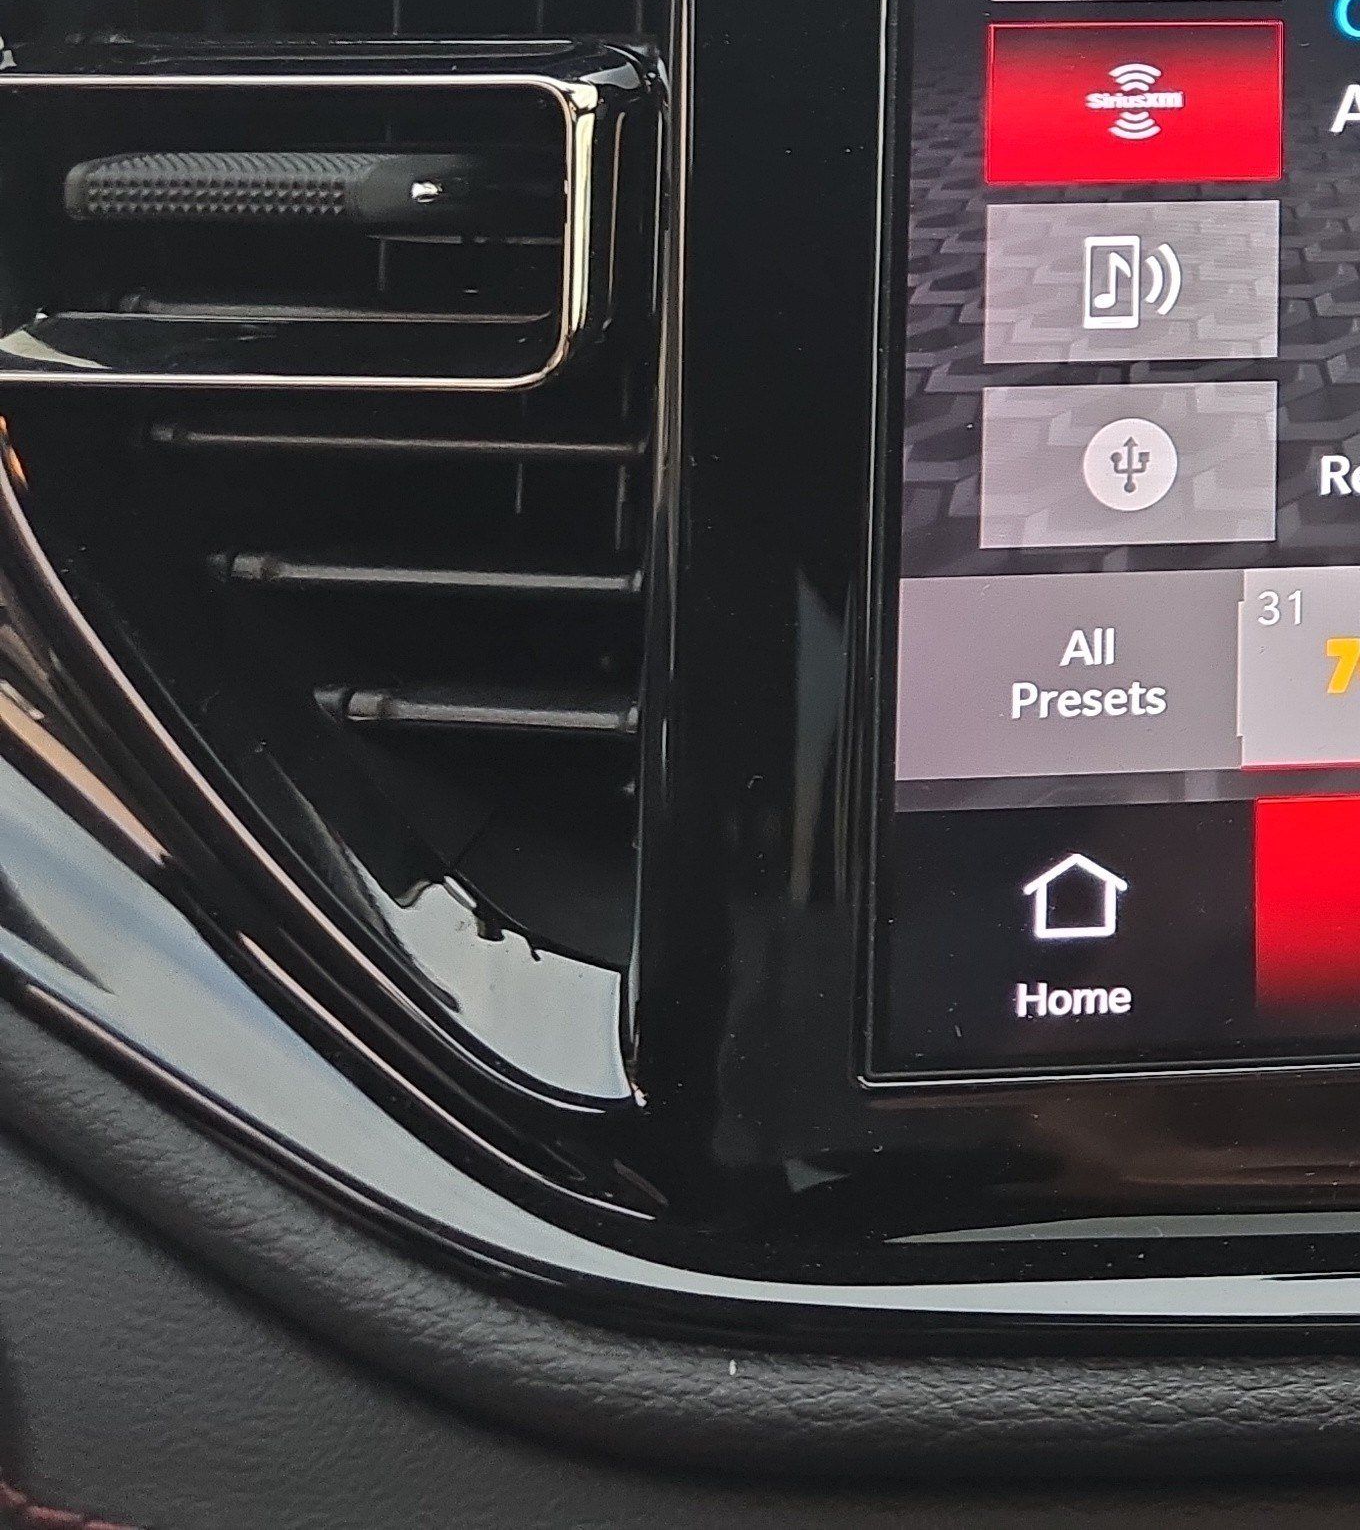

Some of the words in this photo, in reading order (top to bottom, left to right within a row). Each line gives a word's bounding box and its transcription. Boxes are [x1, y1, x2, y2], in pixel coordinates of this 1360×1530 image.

[1257, 591, 1303, 625] 31
[1060, 629, 1115, 665] All
[1011, 682, 1167, 718] Presets
[1015, 981, 1132, 1019] Home
